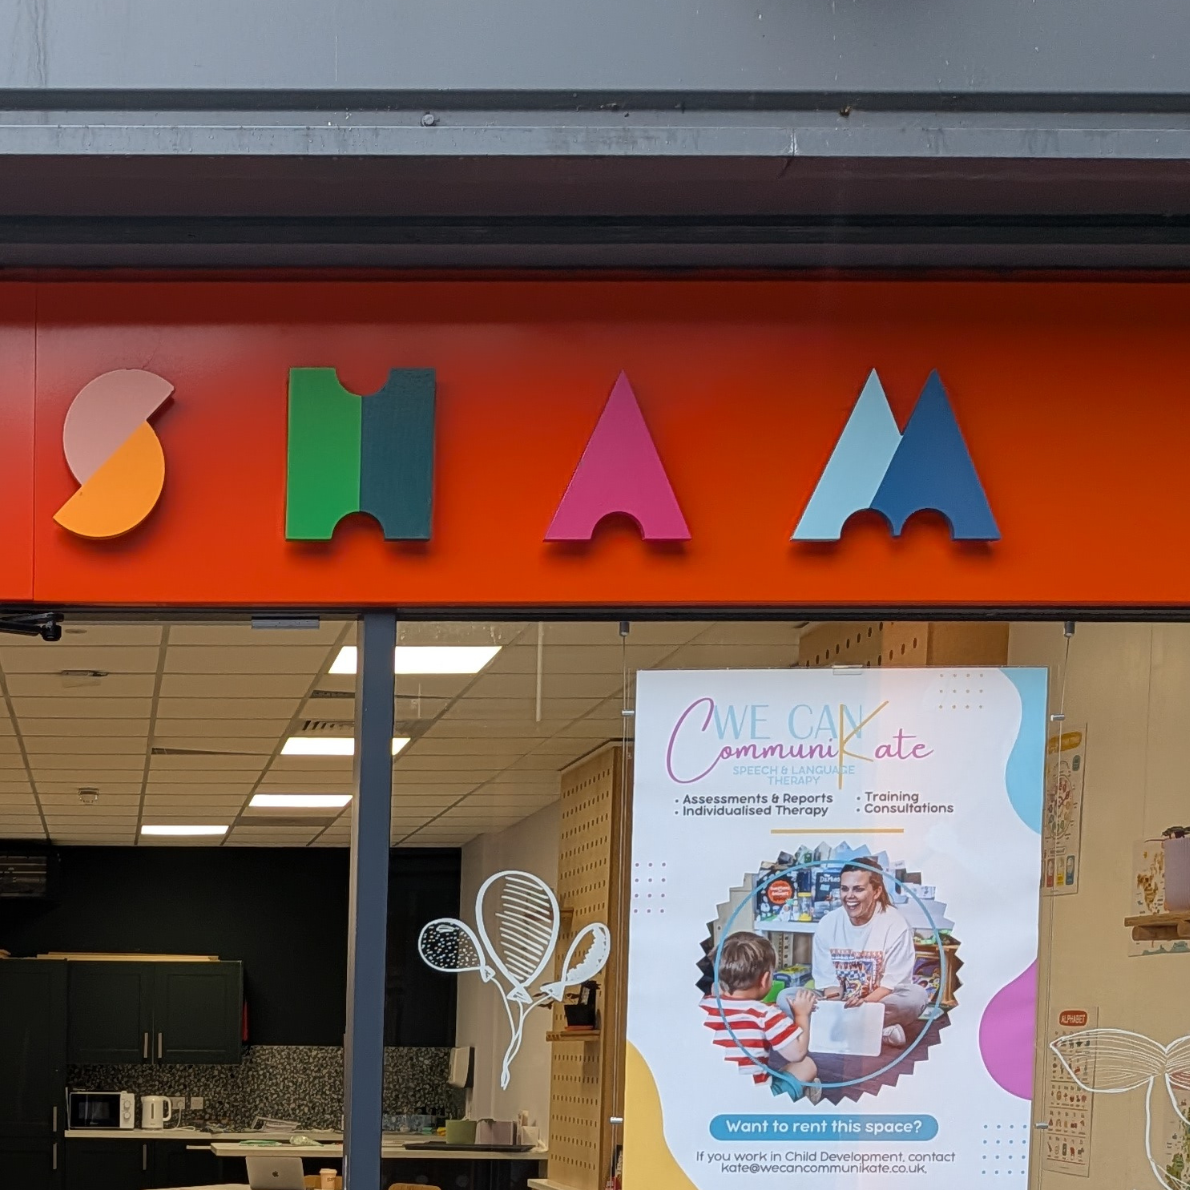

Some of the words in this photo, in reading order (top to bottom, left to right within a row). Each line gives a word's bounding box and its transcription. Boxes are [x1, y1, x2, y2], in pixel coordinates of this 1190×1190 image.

[713, 704, 771, 740] WE
[788, 704, 863, 741] CAN
[666, 697, 935, 790] CommuniKate
[732, 765, 778, 775] SPEECH
[781, 765, 788, 775] &
[791, 765, 856, 775] LANGUAGE
[767, 776, 821, 786] THERAPY
[682, 793, 768, 804] Assessments
[771, 794, 780, 804] &
[782, 793, 834, 806] Reports
[864, 791, 920, 803] Training
[682, 805, 772, 816] Individualised
[775, 805, 829, 817] Therapy
[864, 803, 955, 815] Consultations
[1060, 1014, 1087, 1024] ALPHABET
[725, 1119, 769, 1133] Want
[772, 1120, 789, 1133] to
[792, 1121, 828, 1133] rent
[831, 1119, 861, 1133] this
[864, 1119, 923, 1135] space?
[696, 1151, 705, 1162] If
[707, 1153, 731, 1164] you
[734, 1151, 768, 1162] work
[770, 1151, 782, 1162] in
[784, 1151, 818, 1162] Child
[907, 1151, 956, 1162] contact
